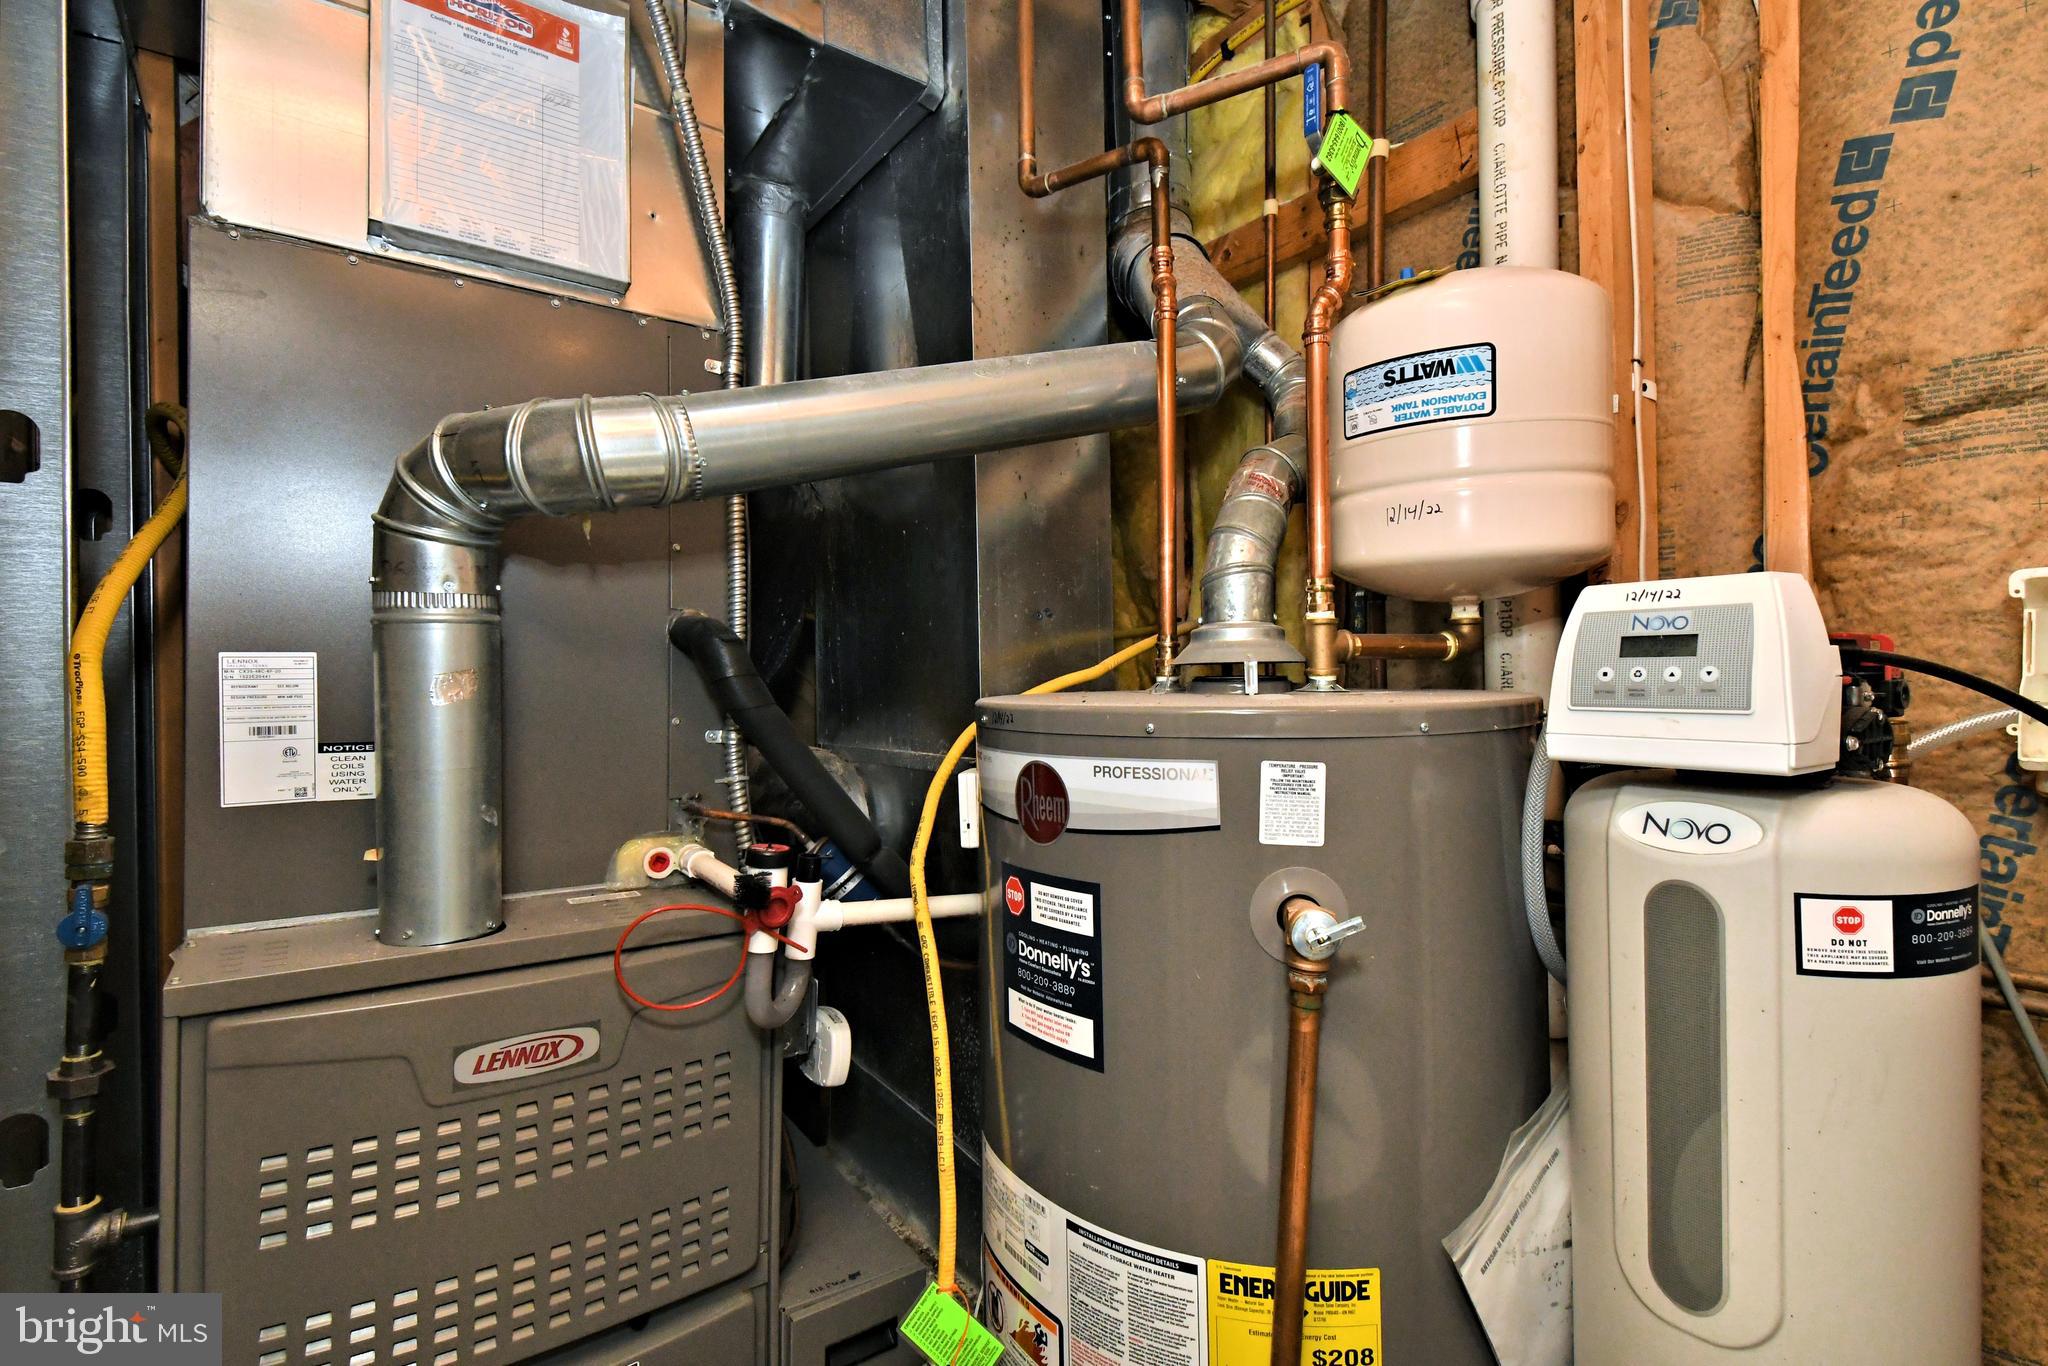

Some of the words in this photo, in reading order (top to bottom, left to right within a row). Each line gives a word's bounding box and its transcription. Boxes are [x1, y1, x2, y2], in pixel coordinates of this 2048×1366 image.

[463, 33, 486, 46] RECORD
[496, 45, 518, 56] SERVICE
[1494, 221, 1507, 251] PIPE
[1383, 359, 1456, 387] WATTS
[1391, 400, 1419, 413] TANK
[1421, 391, 1487, 406] EXPANSION
[1394, 411, 1430, 422] WATER
[1433, 403, 1485, 416] POTABLE
[1386, 500, 1444, 526] 12/14/22
[1626, 589, 1681, 602] 12/14/22
[1020, 765, 1066, 831] Rheem
[1007, 889, 1022, 902] STOP
[1836, 916, 1861, 925] STOP
[1927, 904, 1972, 922] Donnelly's
[1039, 938, 1058, 948] HEATING
[1063, 946, 1088, 956] PLUMBING
[1831, 939, 1845, 947] DO
[1848, 939, 1868, 947] NOT
[1018, 939, 1091, 980] Donnelly's
[1018, 968, 1075, 996] 800-209-3889
[472, 1039, 564, 1075] LENNOX
[1079, 1228, 1111, 1248] INSTALLATION
[1112, 1243, 1123, 1253] AND
[1124, 1246, 1155, 1262] OPERATION
[1156, 1258, 1179, 1269] DETAILS
[1083, 1242, 1109, 1258] AUTOMATIC
[1109, 1254, 1133, 1268] STORAGE
[1133, 1263, 1152, 1274] WATER
[1153, 1269, 1175, 1280] HEATER
[1312, 1348, 1374, 1366] $208
